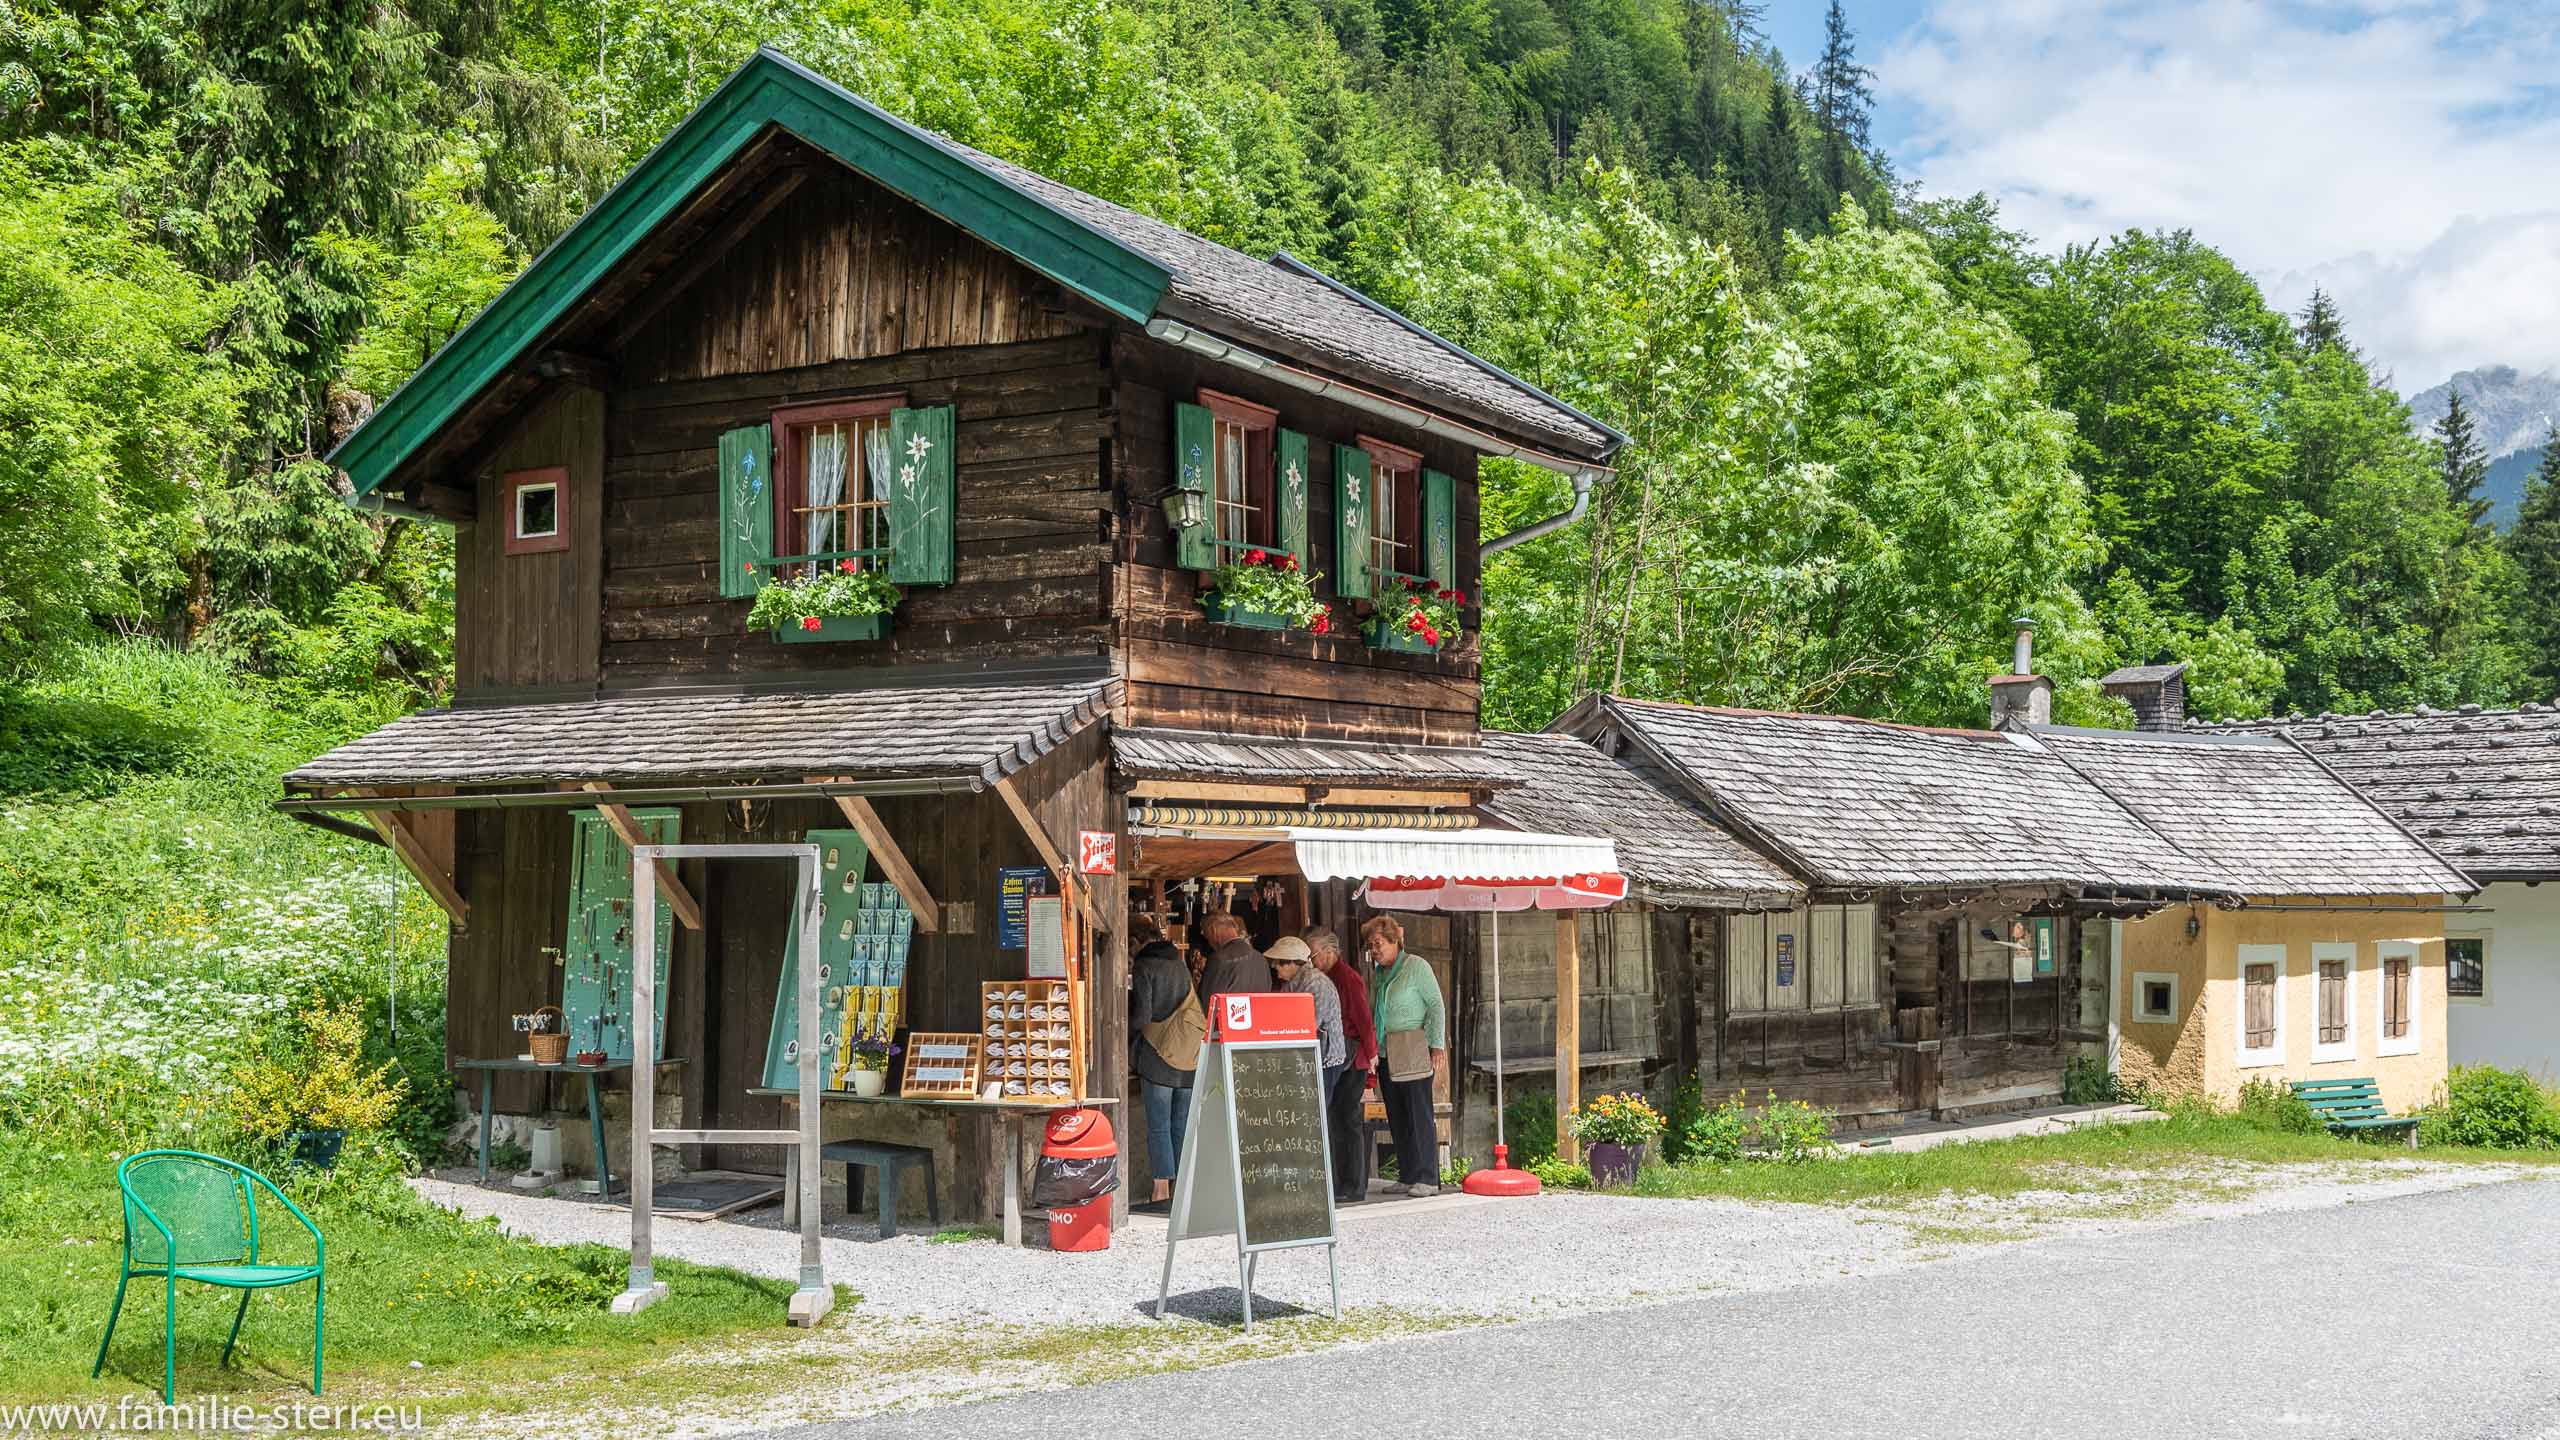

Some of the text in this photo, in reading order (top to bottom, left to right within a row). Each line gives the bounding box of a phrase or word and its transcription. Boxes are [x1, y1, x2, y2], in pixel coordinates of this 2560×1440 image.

[1083, 835, 1114, 870] Stiegl
[1231, 1003, 1247, 1018] Stiegl
[1237, 1108, 1275, 1127] Mineral
